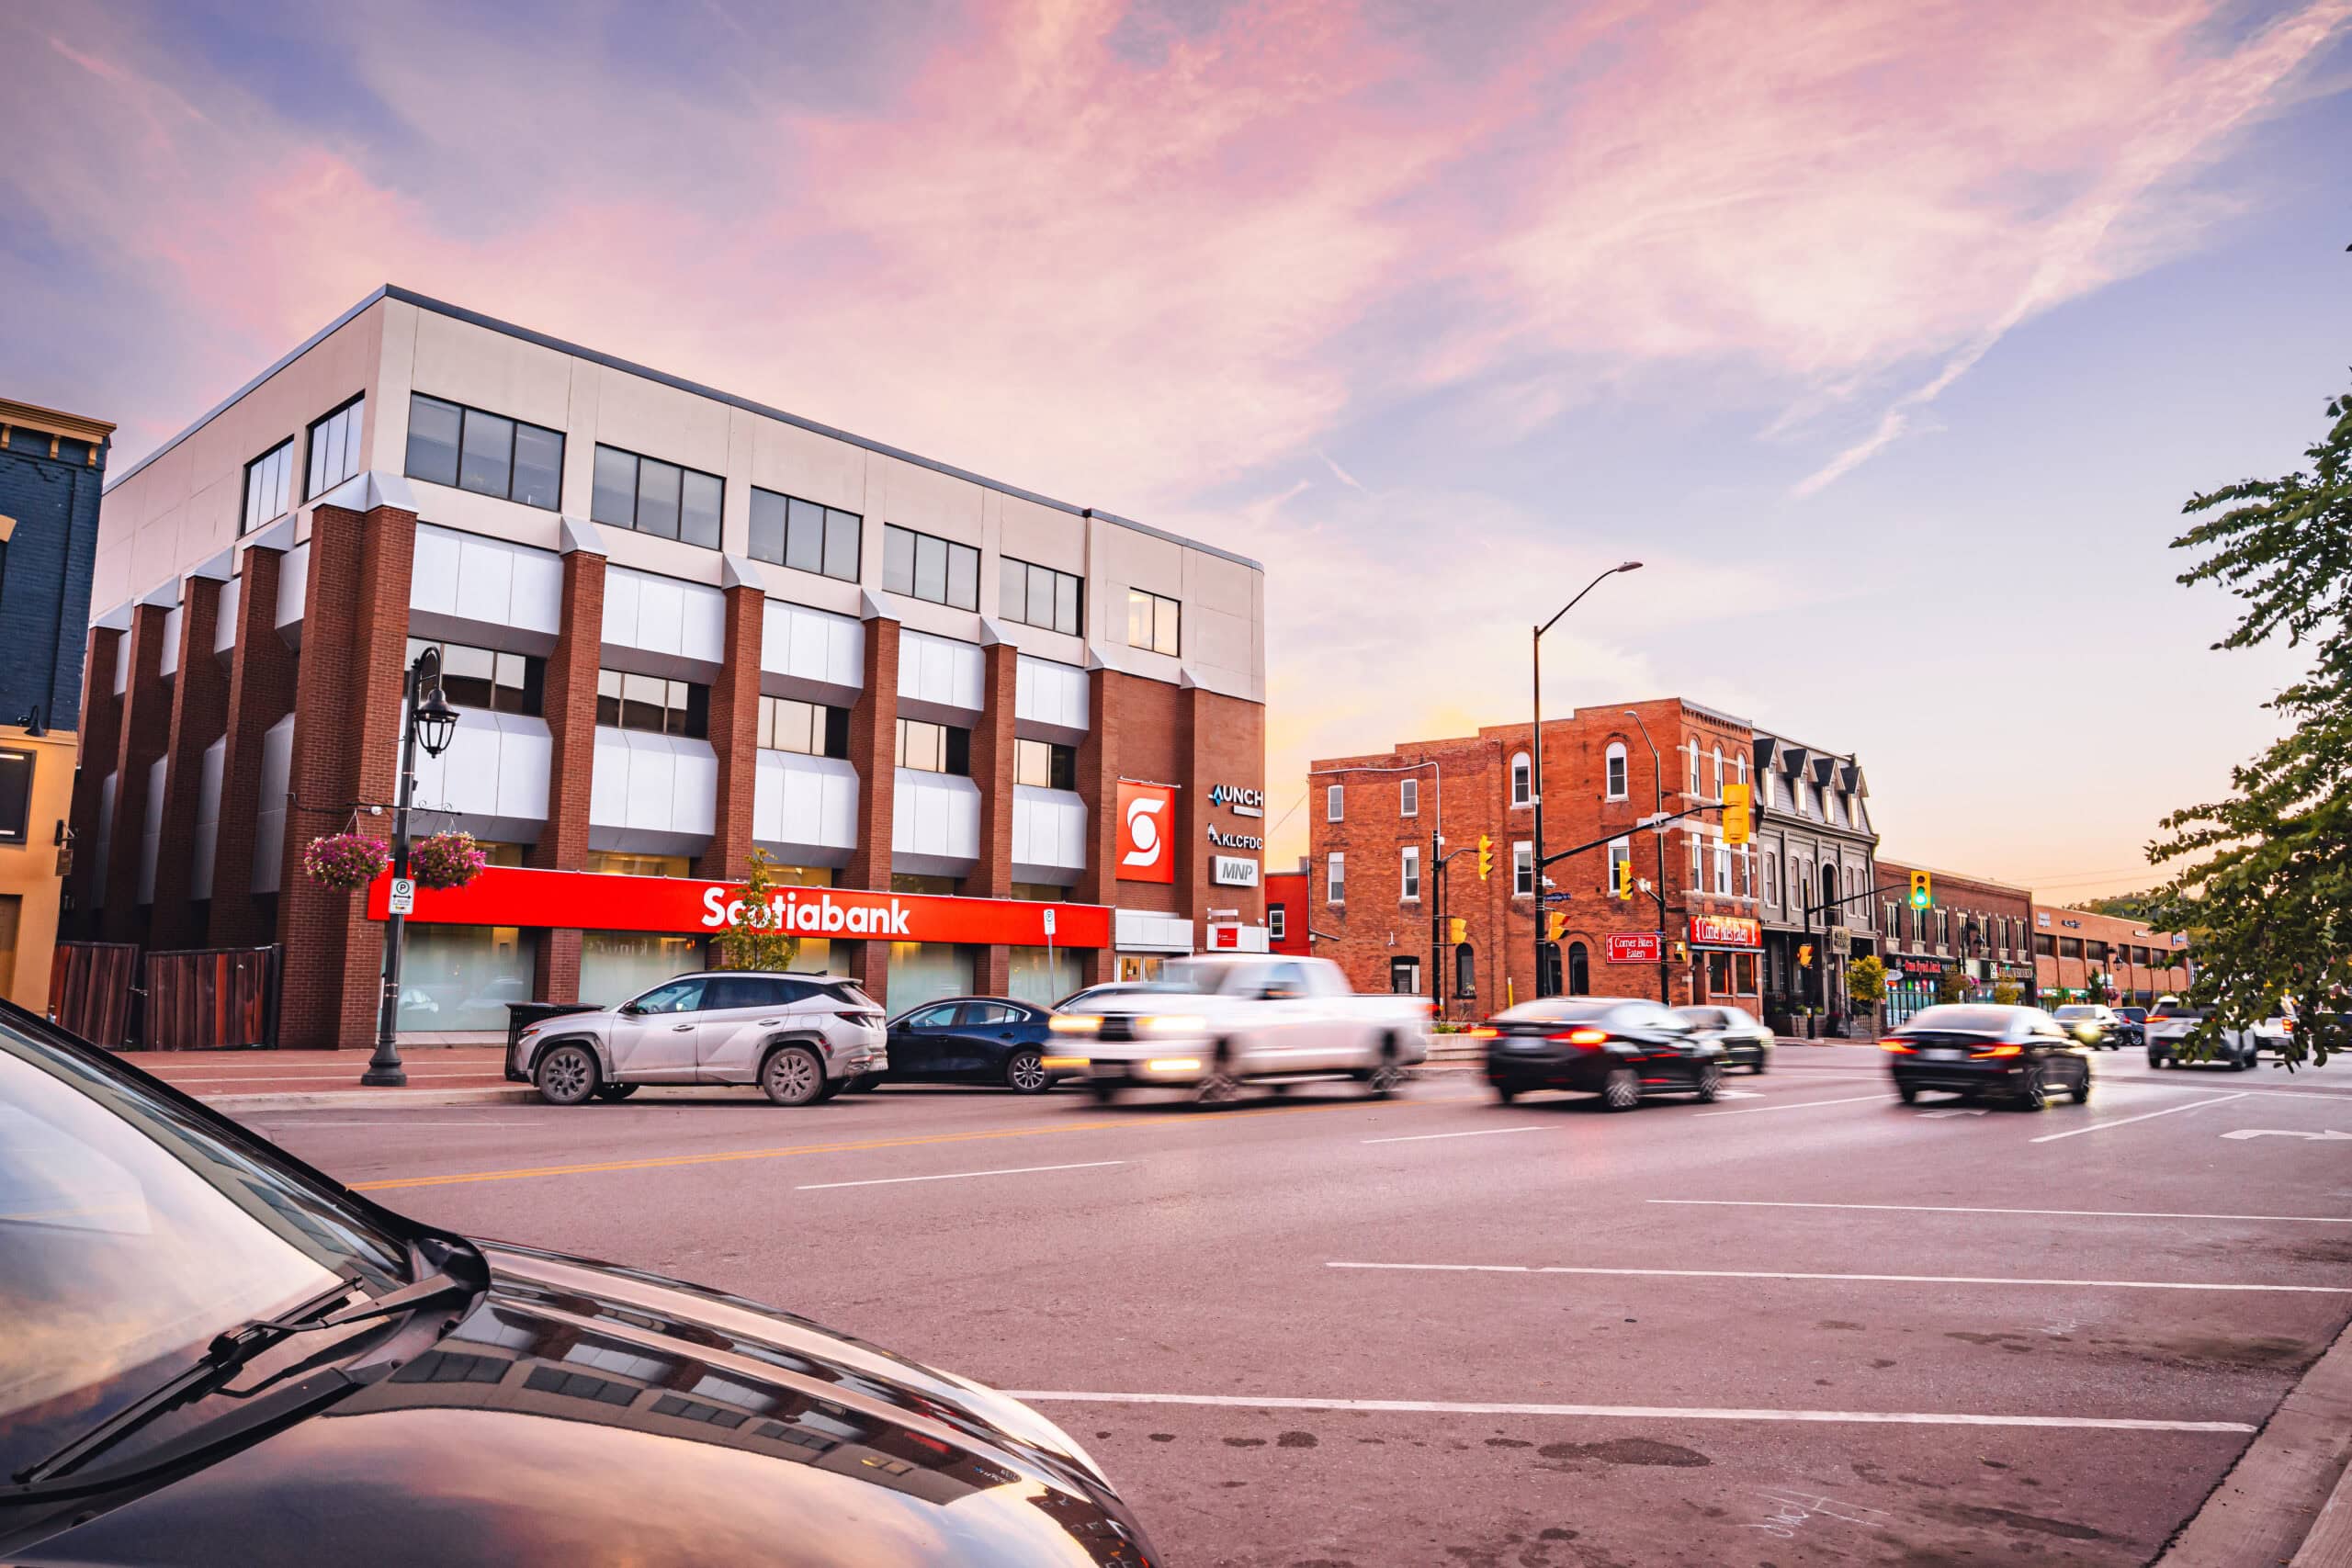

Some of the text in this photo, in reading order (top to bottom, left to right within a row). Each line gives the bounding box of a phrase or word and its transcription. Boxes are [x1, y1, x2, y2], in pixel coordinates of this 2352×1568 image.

[1222, 832, 1263, 850] KLCFDC
[1222, 863, 1253, 881] MNP
[701, 886, 910, 935] Scotiabank
[1614, 937, 1636, 948] Corner
